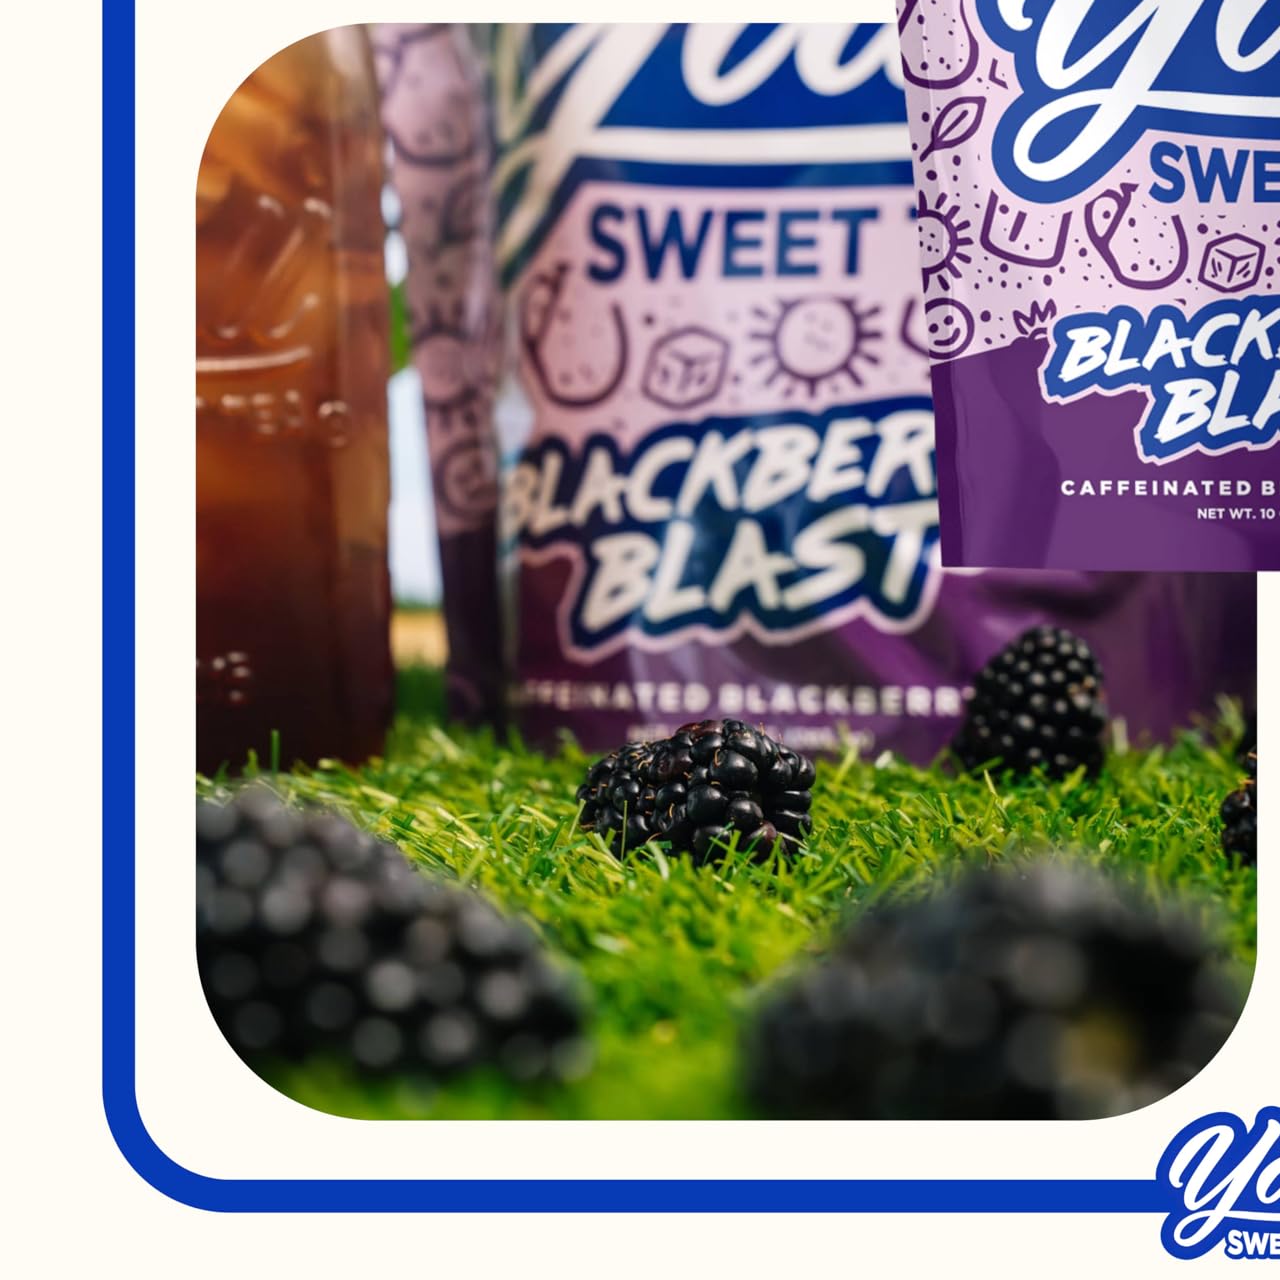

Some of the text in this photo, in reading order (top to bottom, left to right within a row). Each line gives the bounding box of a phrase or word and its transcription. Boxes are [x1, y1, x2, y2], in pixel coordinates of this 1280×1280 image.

[587, 203, 878, 284] SWEET
[502, 410, 935, 535] BLACKBER
[1060, 480, 1252, 496] CAFFEINATED
[1197, 508, 1225, 519] NET
[1229, 508, 1256, 519] WT.
[1260, 508, 1276, 519] 10
[581, 499, 940, 631] BLAST
[718, 681, 977, 717] BLACKBERR
